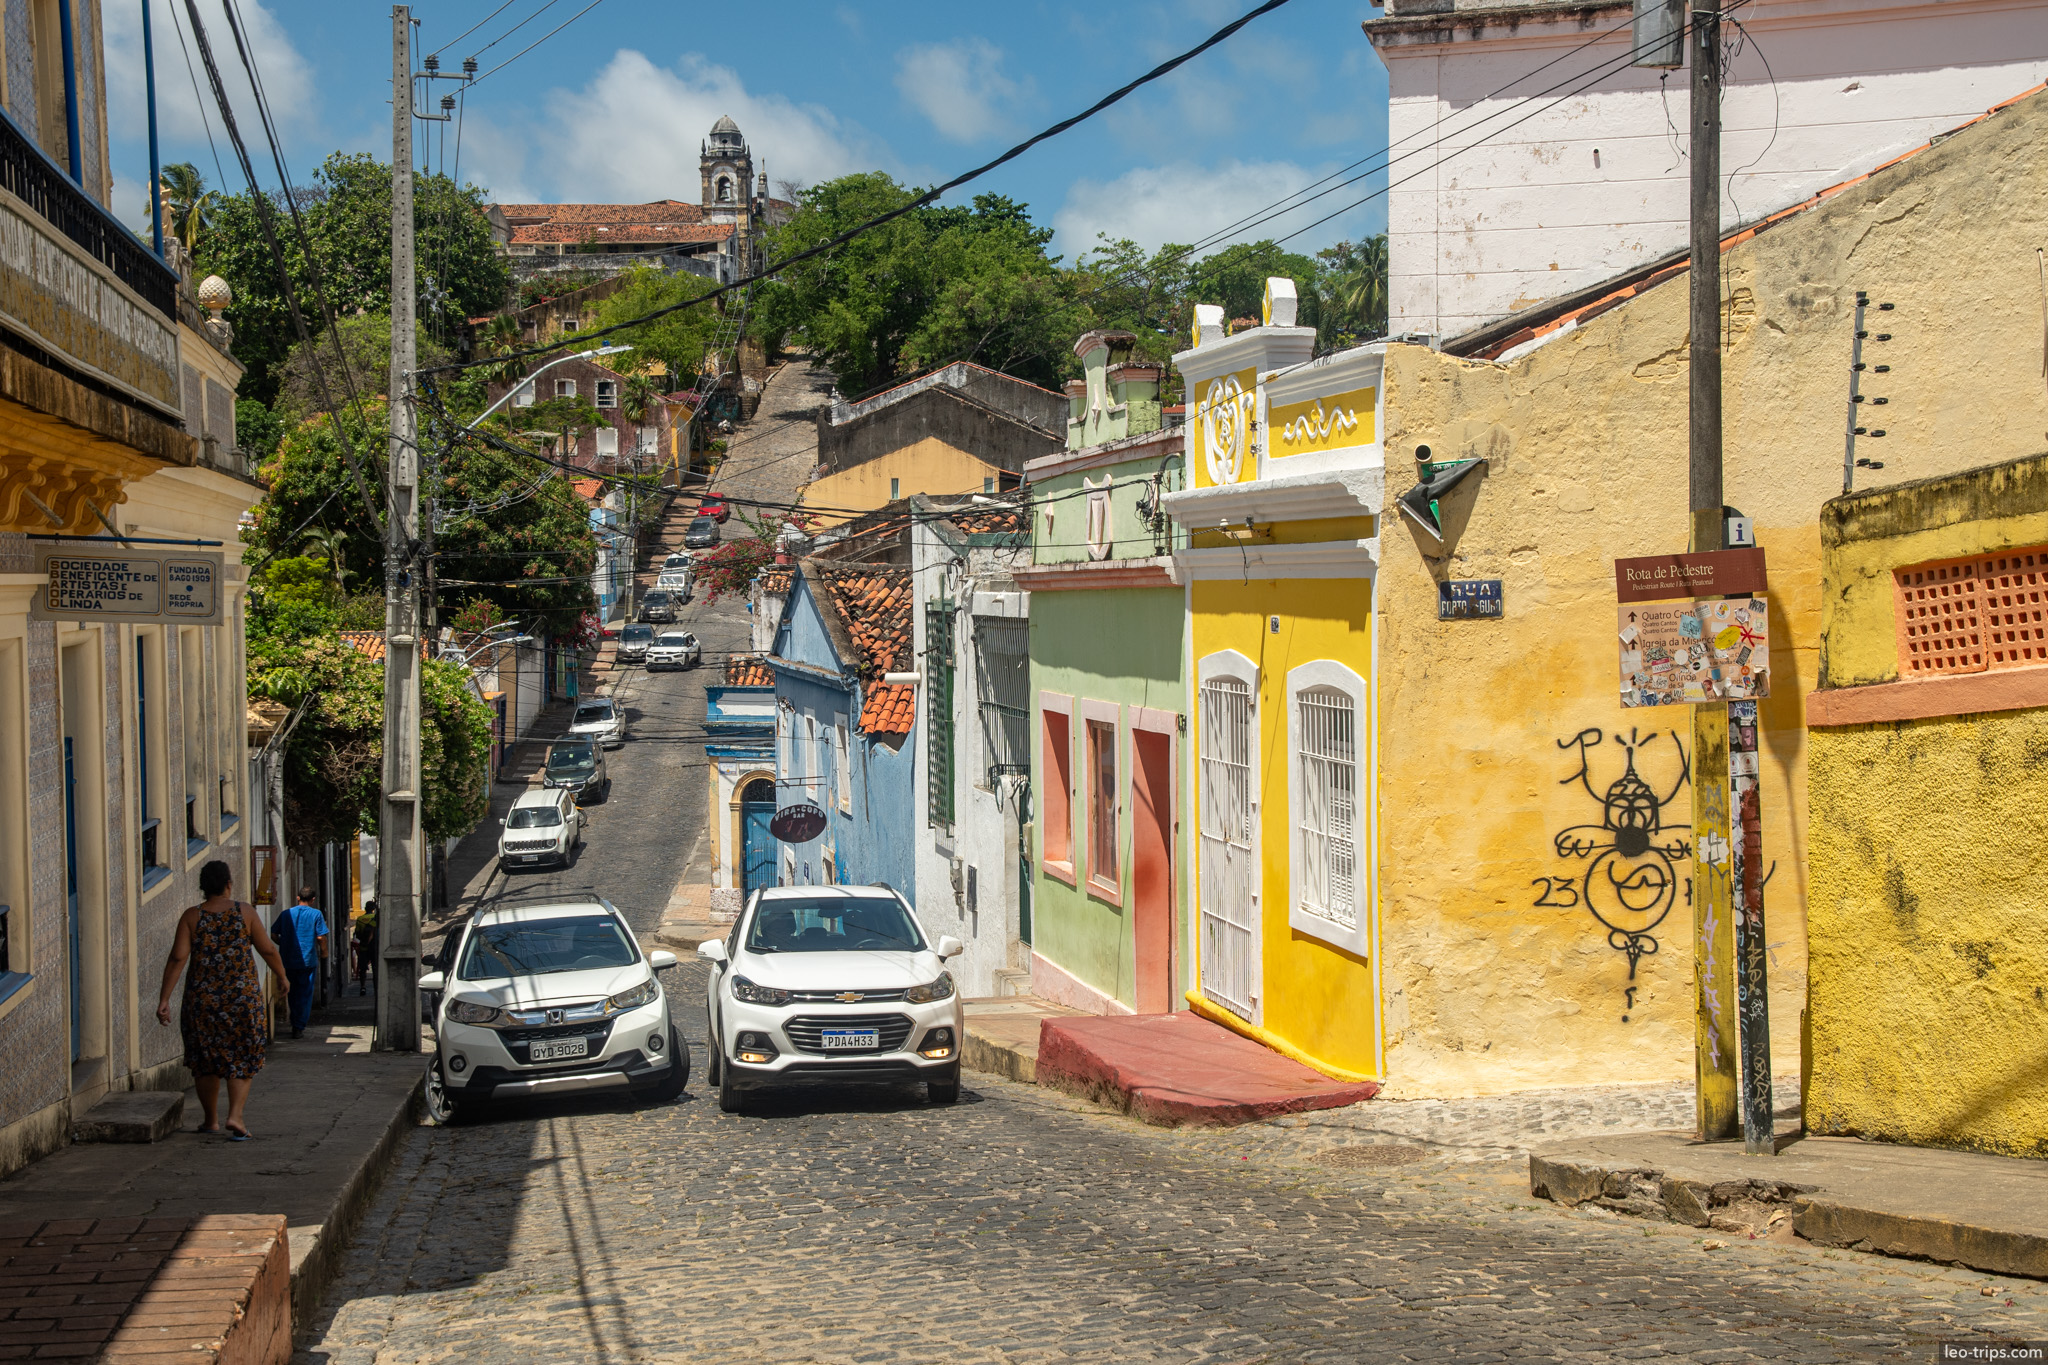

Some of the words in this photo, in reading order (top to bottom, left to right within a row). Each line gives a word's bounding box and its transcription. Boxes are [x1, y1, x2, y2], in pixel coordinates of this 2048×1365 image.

[50, 560, 129, 572] SOCIEDADE
[168, 566, 211, 575] FUNDADA
[1626, 567, 1652, 581] Rota
[1654, 565, 1667, 579] de
[1669, 563, 1714, 578] Pedestre
[50, 570, 142, 582] BENEFICENTE
[144, 574, 158, 582] DE
[50, 579, 119, 591] ARTISTAS
[121, 583, 128, 591] E
[1450, 583, 1492, 597] RUA
[1632, 582, 1659, 591] Pedestrian
[1659, 580, 1675, 589] Route
[129, 592, 143, 601] DE
[50, 598, 103, 610] OLINDA
[1641, 610, 1672, 622] Quatro
[1641, 621, 1660, 629] Quatro
[1642, 638, 1667, 649] Igreja
[1670, 637, 1680, 647] da
[774, 805, 824, 822] VIRA-COPO
[1532, 876, 1578, 907] 23
[828, 1035, 874, 1047] PDA4H33
